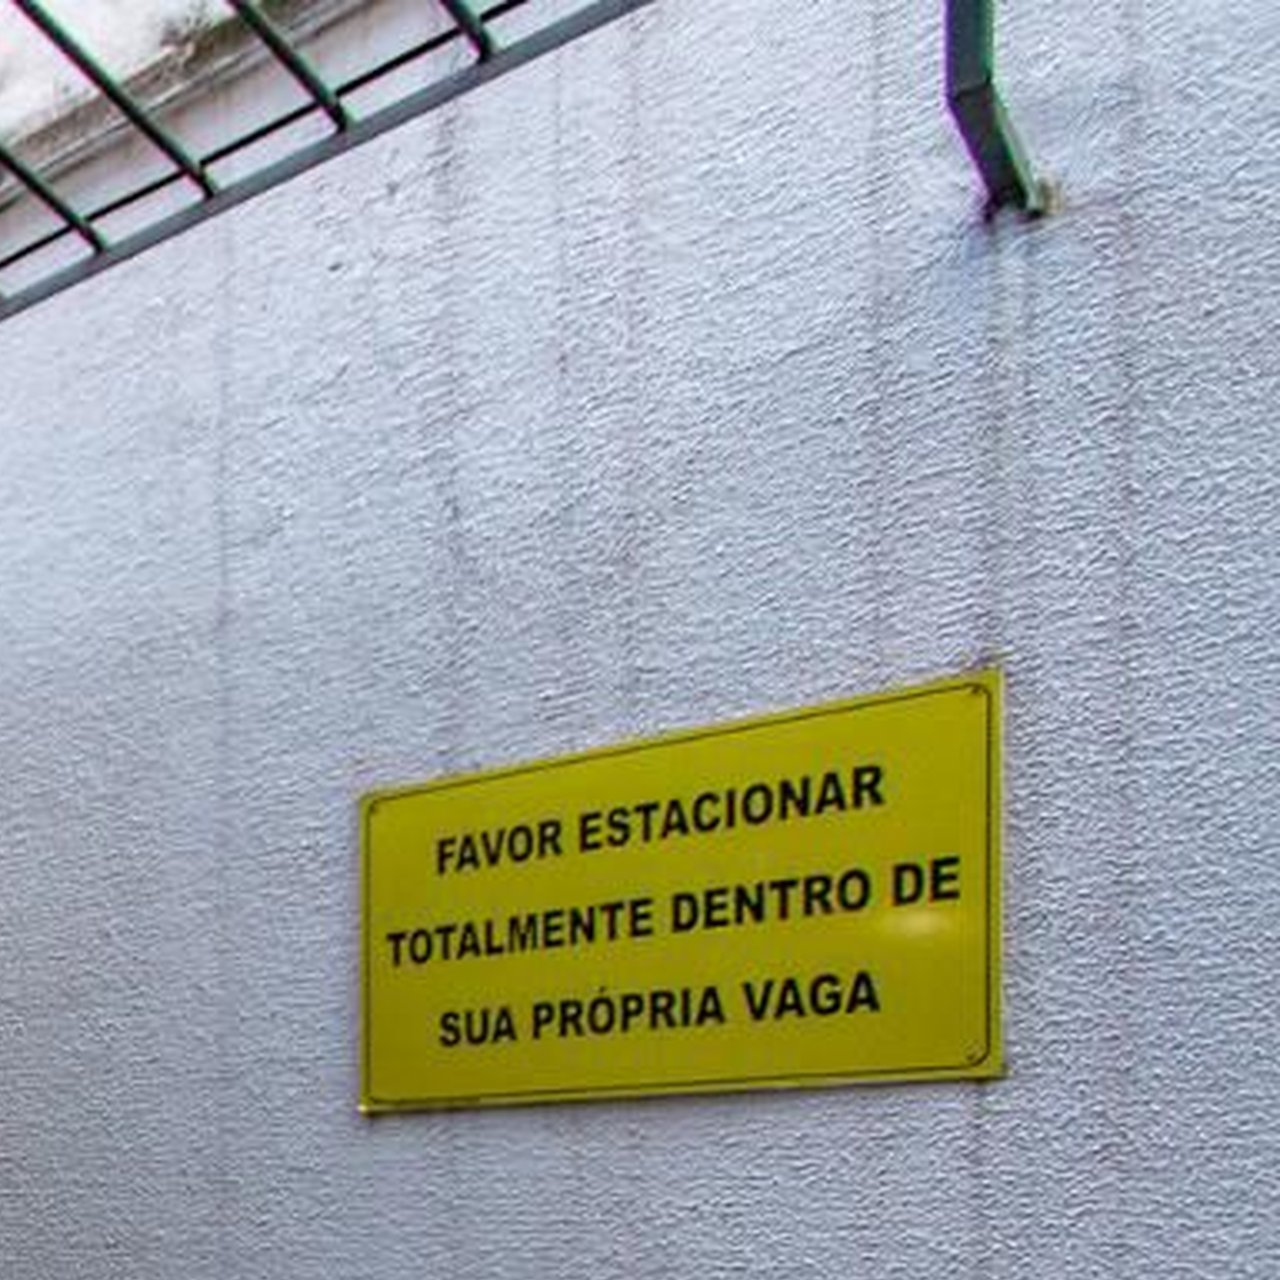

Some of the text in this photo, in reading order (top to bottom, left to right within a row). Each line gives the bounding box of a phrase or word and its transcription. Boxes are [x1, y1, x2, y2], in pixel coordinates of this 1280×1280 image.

[435, 765, 885, 876] FAVOR ESTACIONAR
[385, 856, 961, 968] TOTALMENTE DENTRO DE
[438, 971, 881, 1049] SUA PRÓPRIA VAGA
